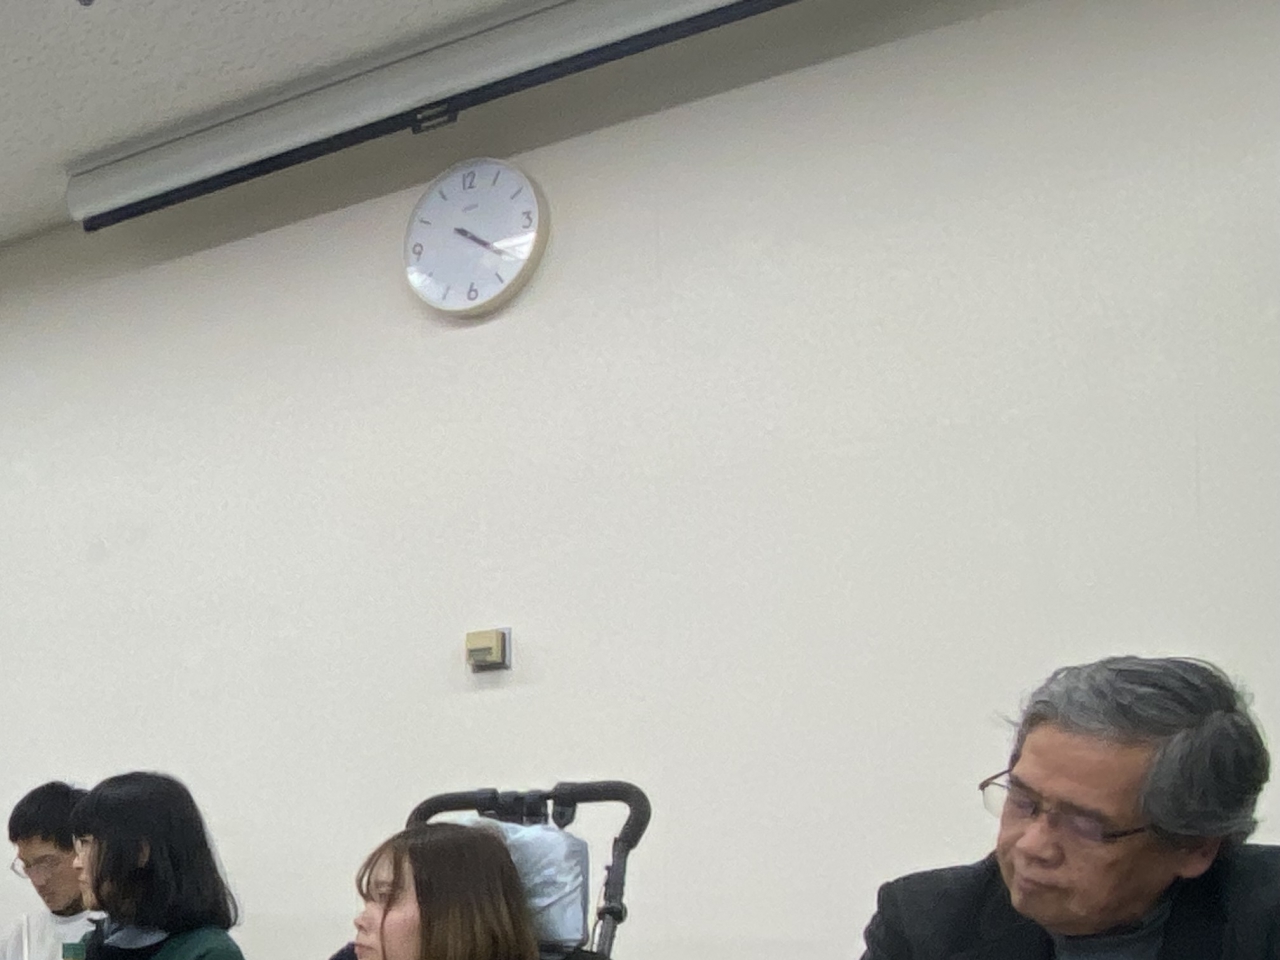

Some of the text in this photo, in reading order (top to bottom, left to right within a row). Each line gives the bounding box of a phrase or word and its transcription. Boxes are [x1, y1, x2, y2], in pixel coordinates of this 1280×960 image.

[462, 170, 477, 190] 12
[521, 211, 533, 229] 3
[412, 242, 424, 262] 9
[467, 282, 479, 301] 6
